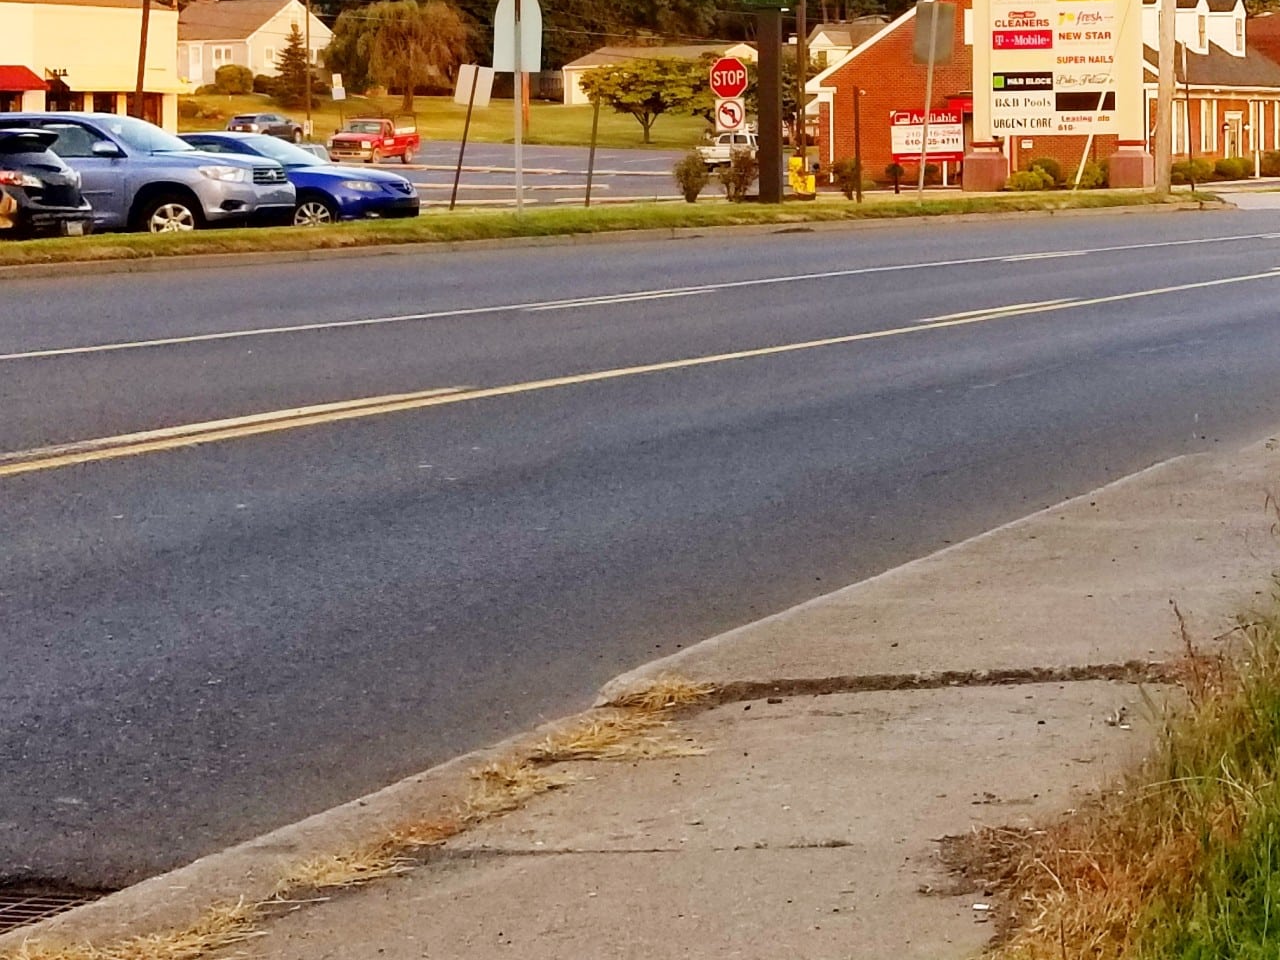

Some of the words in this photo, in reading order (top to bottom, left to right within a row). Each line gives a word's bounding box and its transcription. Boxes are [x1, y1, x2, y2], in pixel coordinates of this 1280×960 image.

[994, 19, 1050, 28] CLEANERS
[1058, 32, 1082, 40] NEW
[1085, 31, 1111, 40] STAR
[1056, 56, 1086, 64] SUPER
[1088, 55, 1114, 64] NAILS
[713, 70, 745, 86] STOP
[995, 98, 1019, 107] B&B
[1024, 98, 1051, 107] Pools
[911, 113, 958, 123] Avilable
[993, 118, 1028, 128] URGENT
[1030, 117, 1052, 128] CARE
